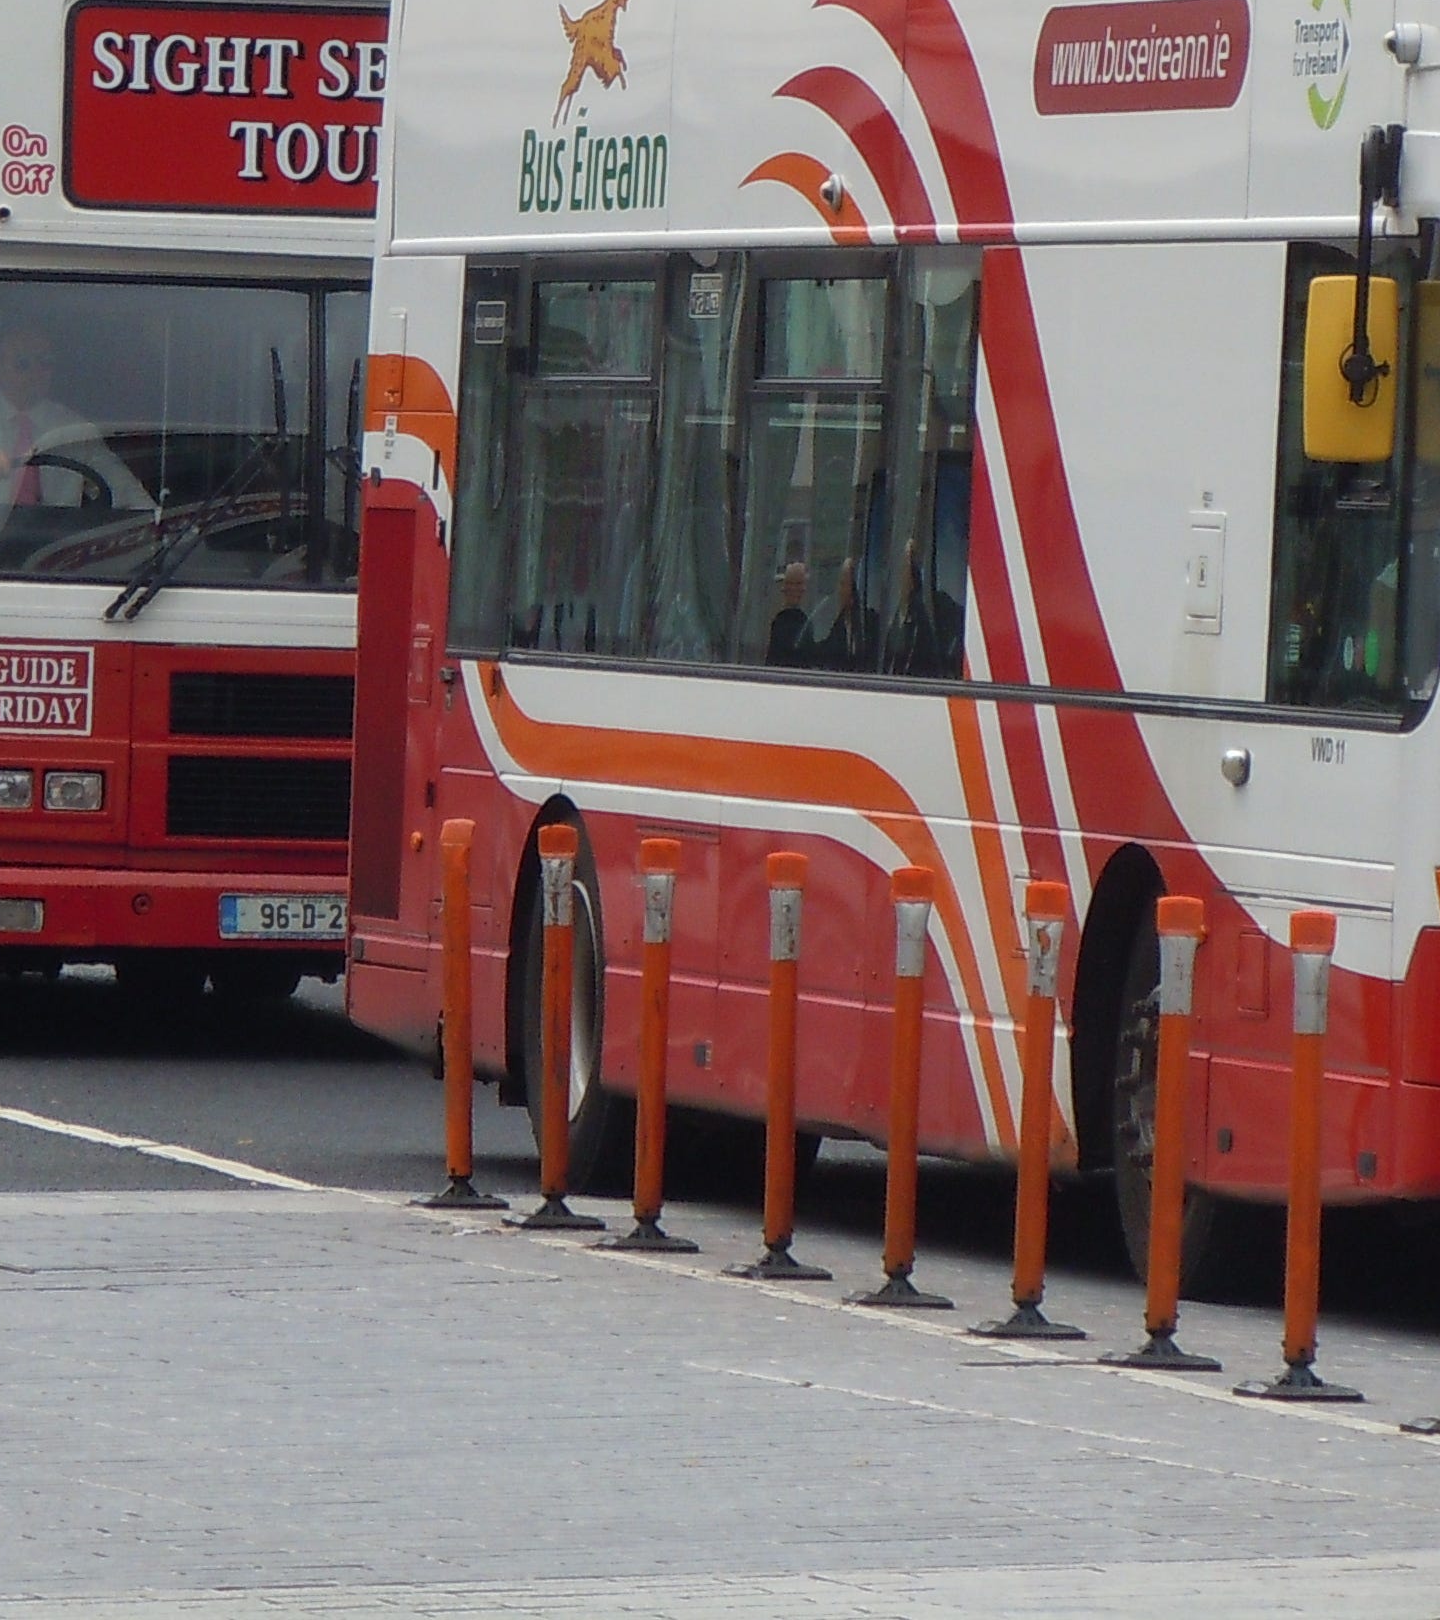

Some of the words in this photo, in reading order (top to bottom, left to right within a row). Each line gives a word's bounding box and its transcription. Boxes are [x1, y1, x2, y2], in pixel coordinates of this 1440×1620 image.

[1051, 19, 1231, 86] www.buseireann.ie
[1295, 18, 1339, 47] Transport
[92, 31, 301, 96] SIGHT
[317, 39, 389, 98] SE
[2, 124, 48, 157] On
[229, 120, 383, 182] TOU
[1, 160, 55, 195] Off
[518, 129, 566, 213] Bus
[260, 903, 347, 930] 96-D-2
